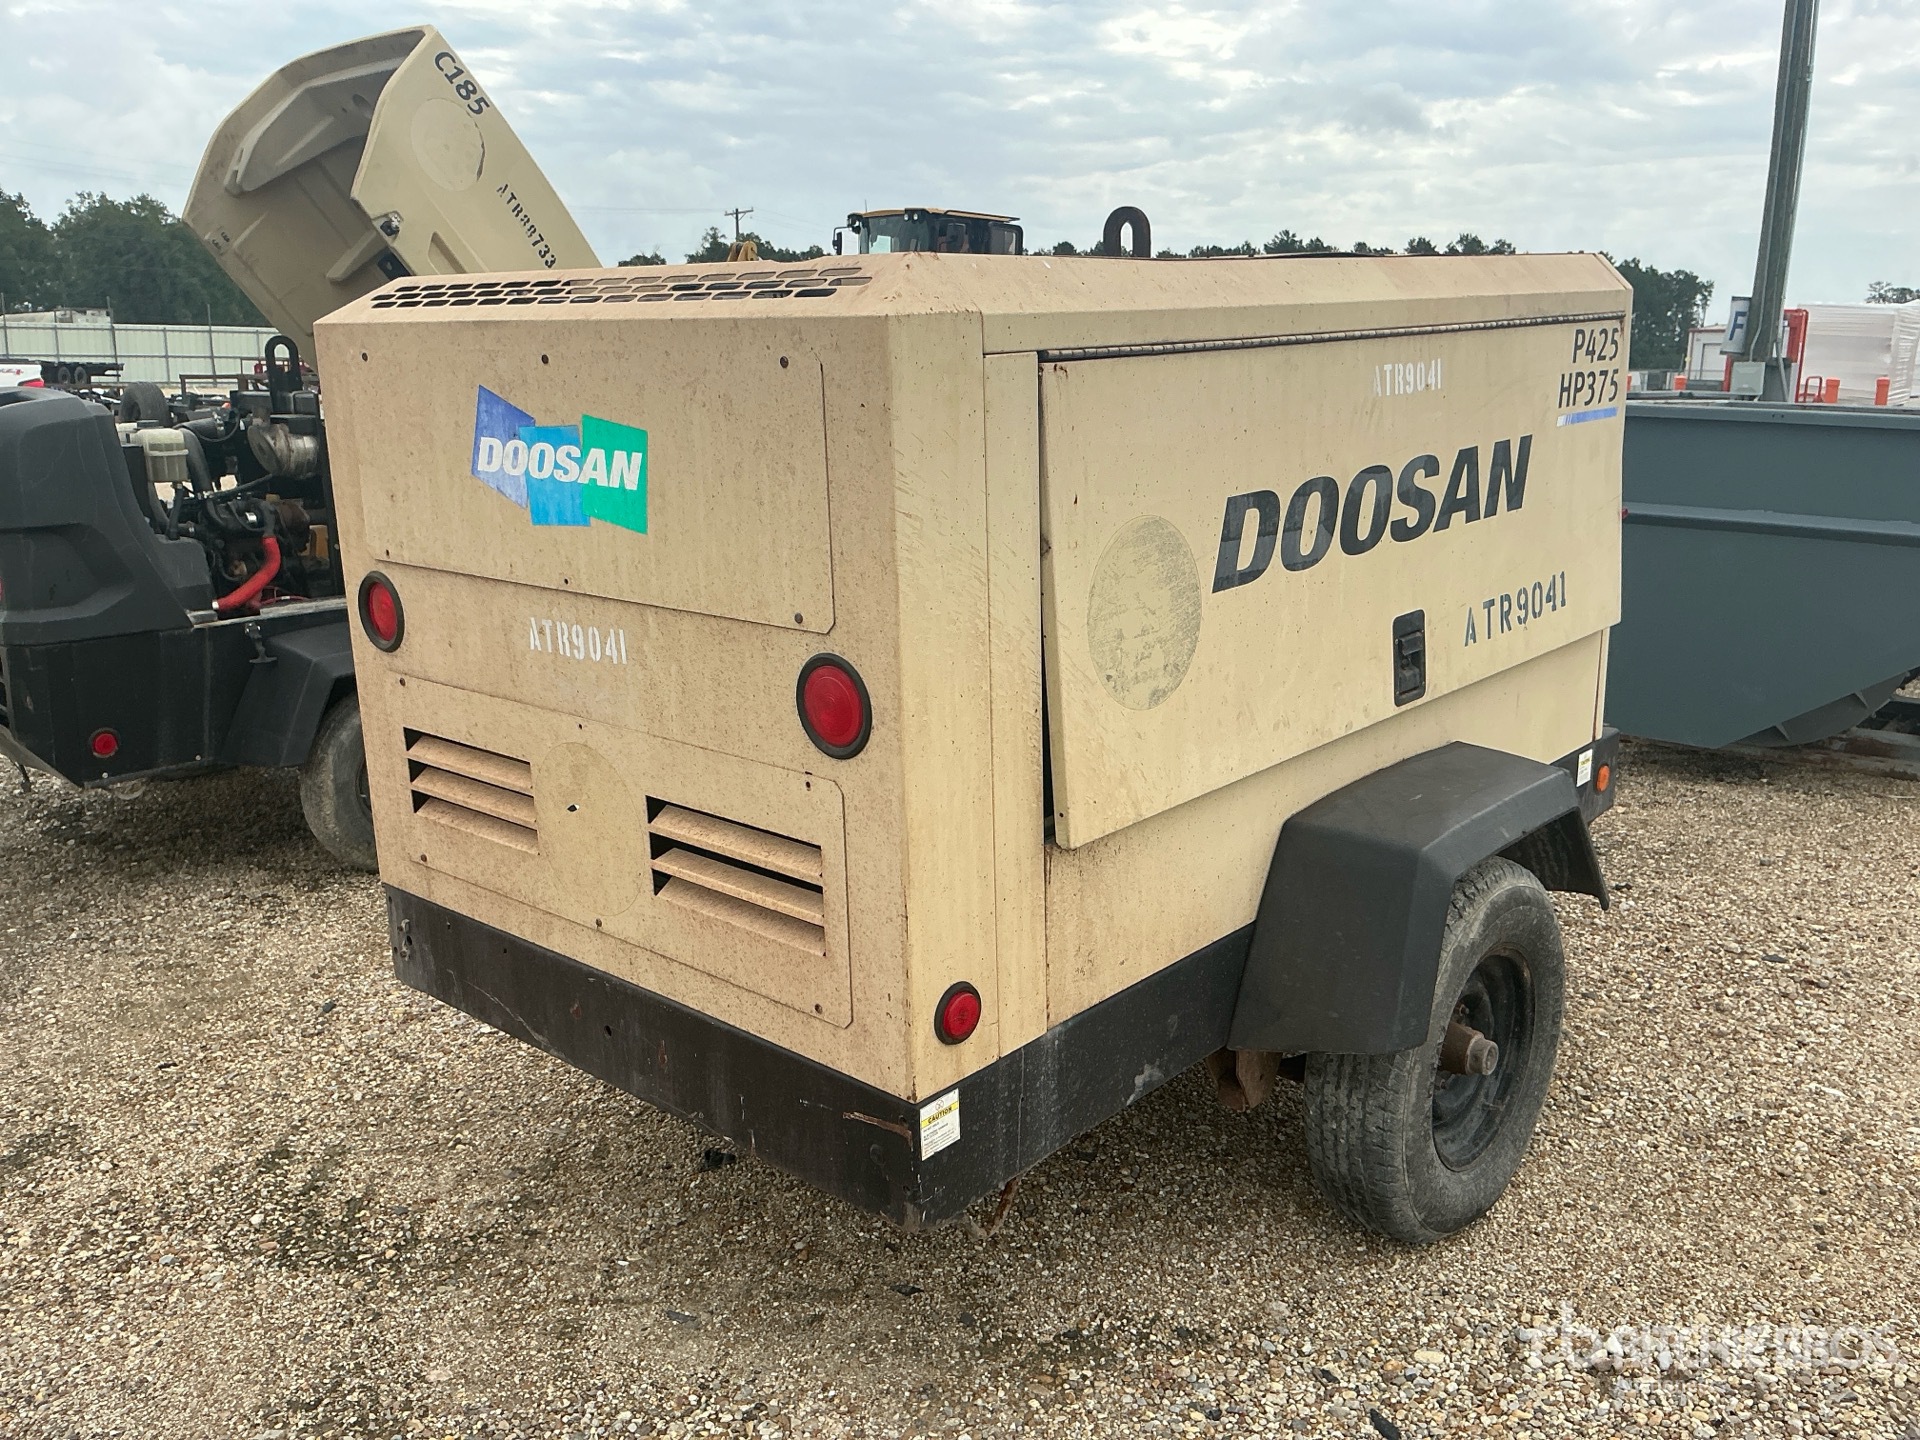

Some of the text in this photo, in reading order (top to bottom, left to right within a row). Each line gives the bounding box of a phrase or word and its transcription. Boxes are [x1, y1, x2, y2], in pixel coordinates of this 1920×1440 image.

[434, 51, 490, 115] C185
[1572, 328, 1619, 363] P425
[1373, 358, 1442, 397] ATR9041
[1558, 368, 1619, 408] HP375
[477, 437, 643, 490] DOOSAN
[1212, 434, 1533, 594] DOOSAN
[1465, 571, 1567, 647] ATR9041
[529, 617, 628, 665] ATR9041
[927, 1106, 952, 1124] CAUTION
